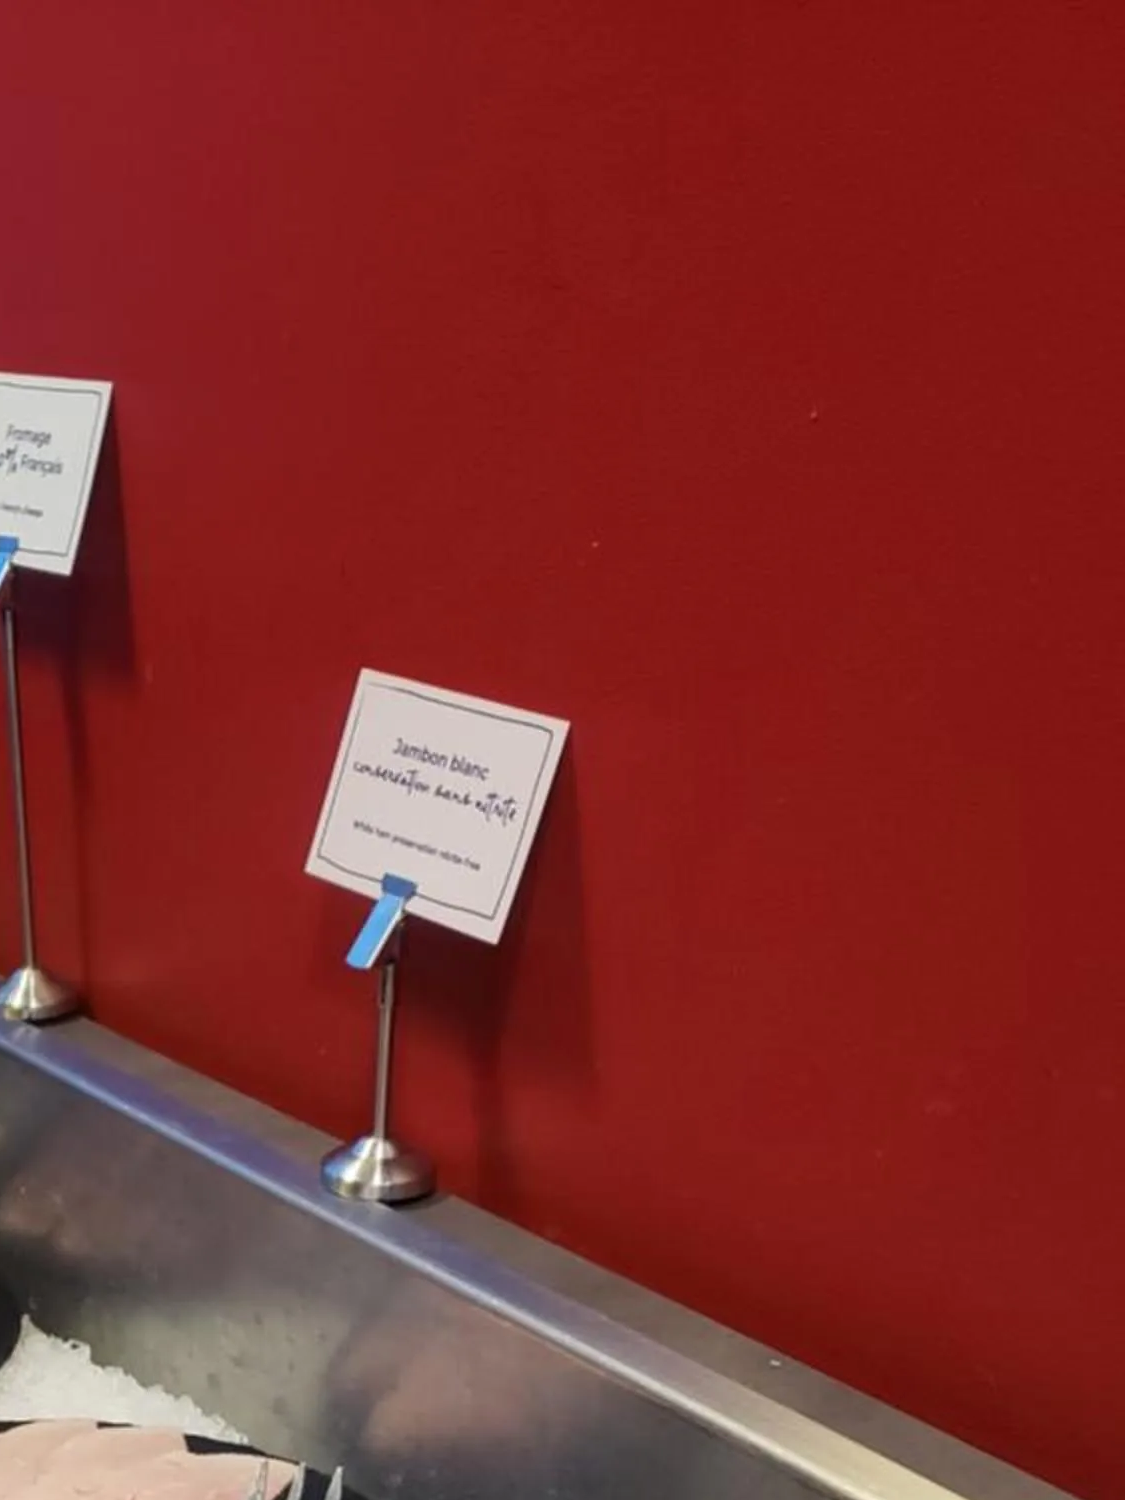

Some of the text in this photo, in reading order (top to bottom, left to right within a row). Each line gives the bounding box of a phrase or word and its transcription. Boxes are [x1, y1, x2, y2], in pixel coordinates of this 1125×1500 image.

[5, 424, 52, 449] Fromage
[19, 453, 64, 478] Français
[392, 737, 490, 781] Jambon blanc
